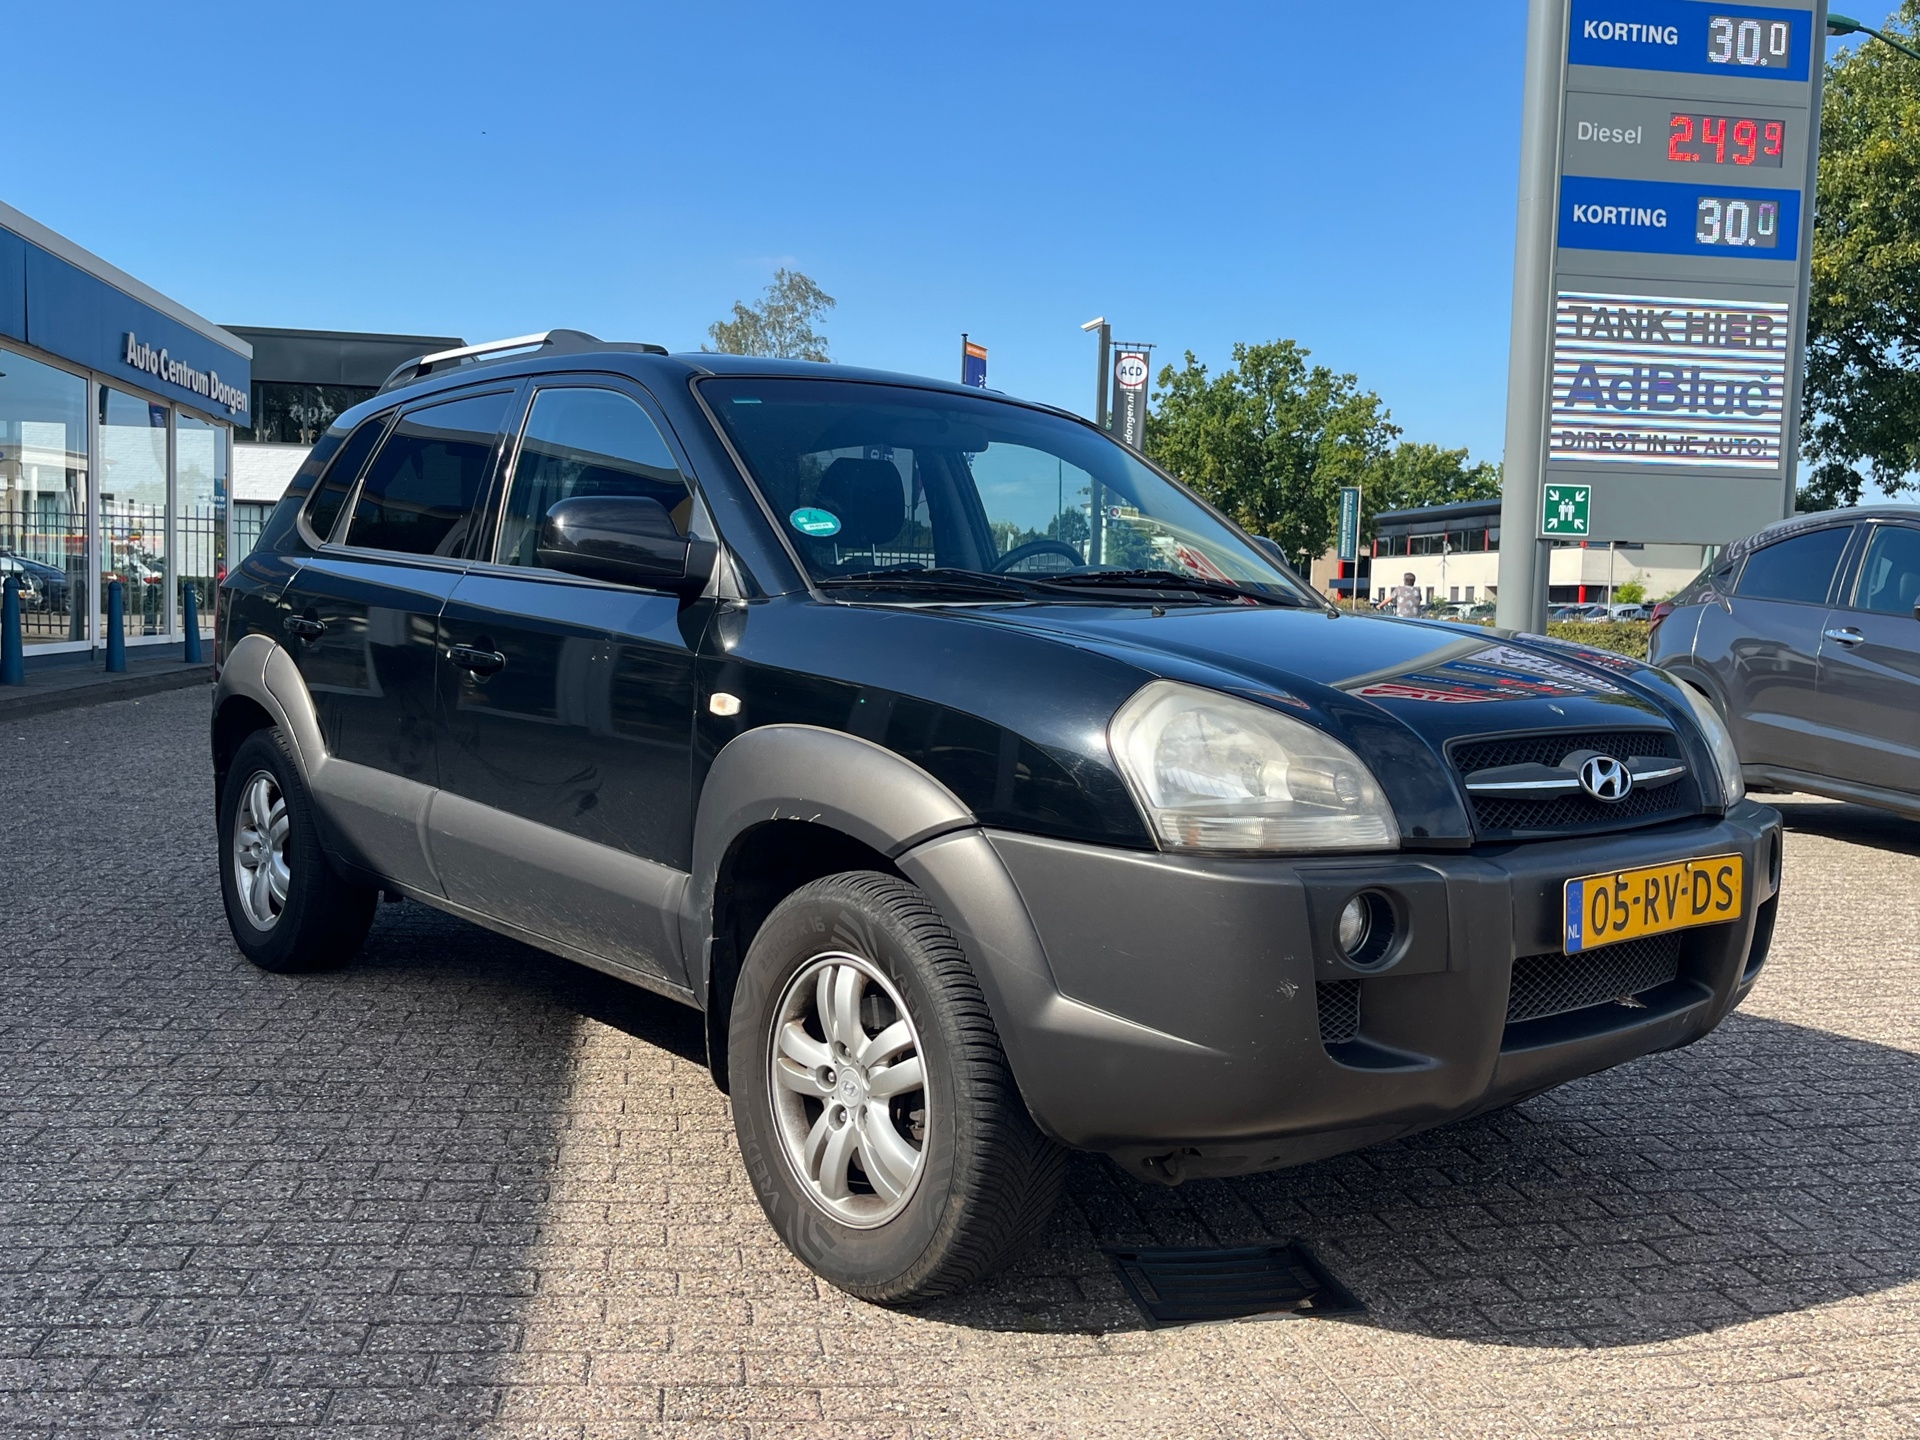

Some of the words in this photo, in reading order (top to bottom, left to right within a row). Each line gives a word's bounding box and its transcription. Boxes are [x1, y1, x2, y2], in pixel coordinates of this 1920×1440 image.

[1583, 20, 1679, 46] KORTING
[1708, 17, 1787, 66] 30.0
[1577, 121, 1642, 145] Diesel
[1572, 204, 1668, 228] KORTING
[1696, 198, 1775, 247] 30.0
[1568, 305, 1674, 343] TANK
[1685, 311, 1775, 349] HIER
[126, 331, 159, 375] Auto
[160, 348, 209, 397] Centrum
[210, 370, 248, 415] Dongen
[1120, 366, 1143, 376] ACD
[1560, 430, 1640, 452] DIRECT
[1646, 434, 1668, 452] IN
[1672, 436, 1699, 455] JE
[1705, 437, 1768, 457] AUTO!
[1591, 865, 1733, 936] 05-RV-DS
[1567, 924, 1581, 940] NL
